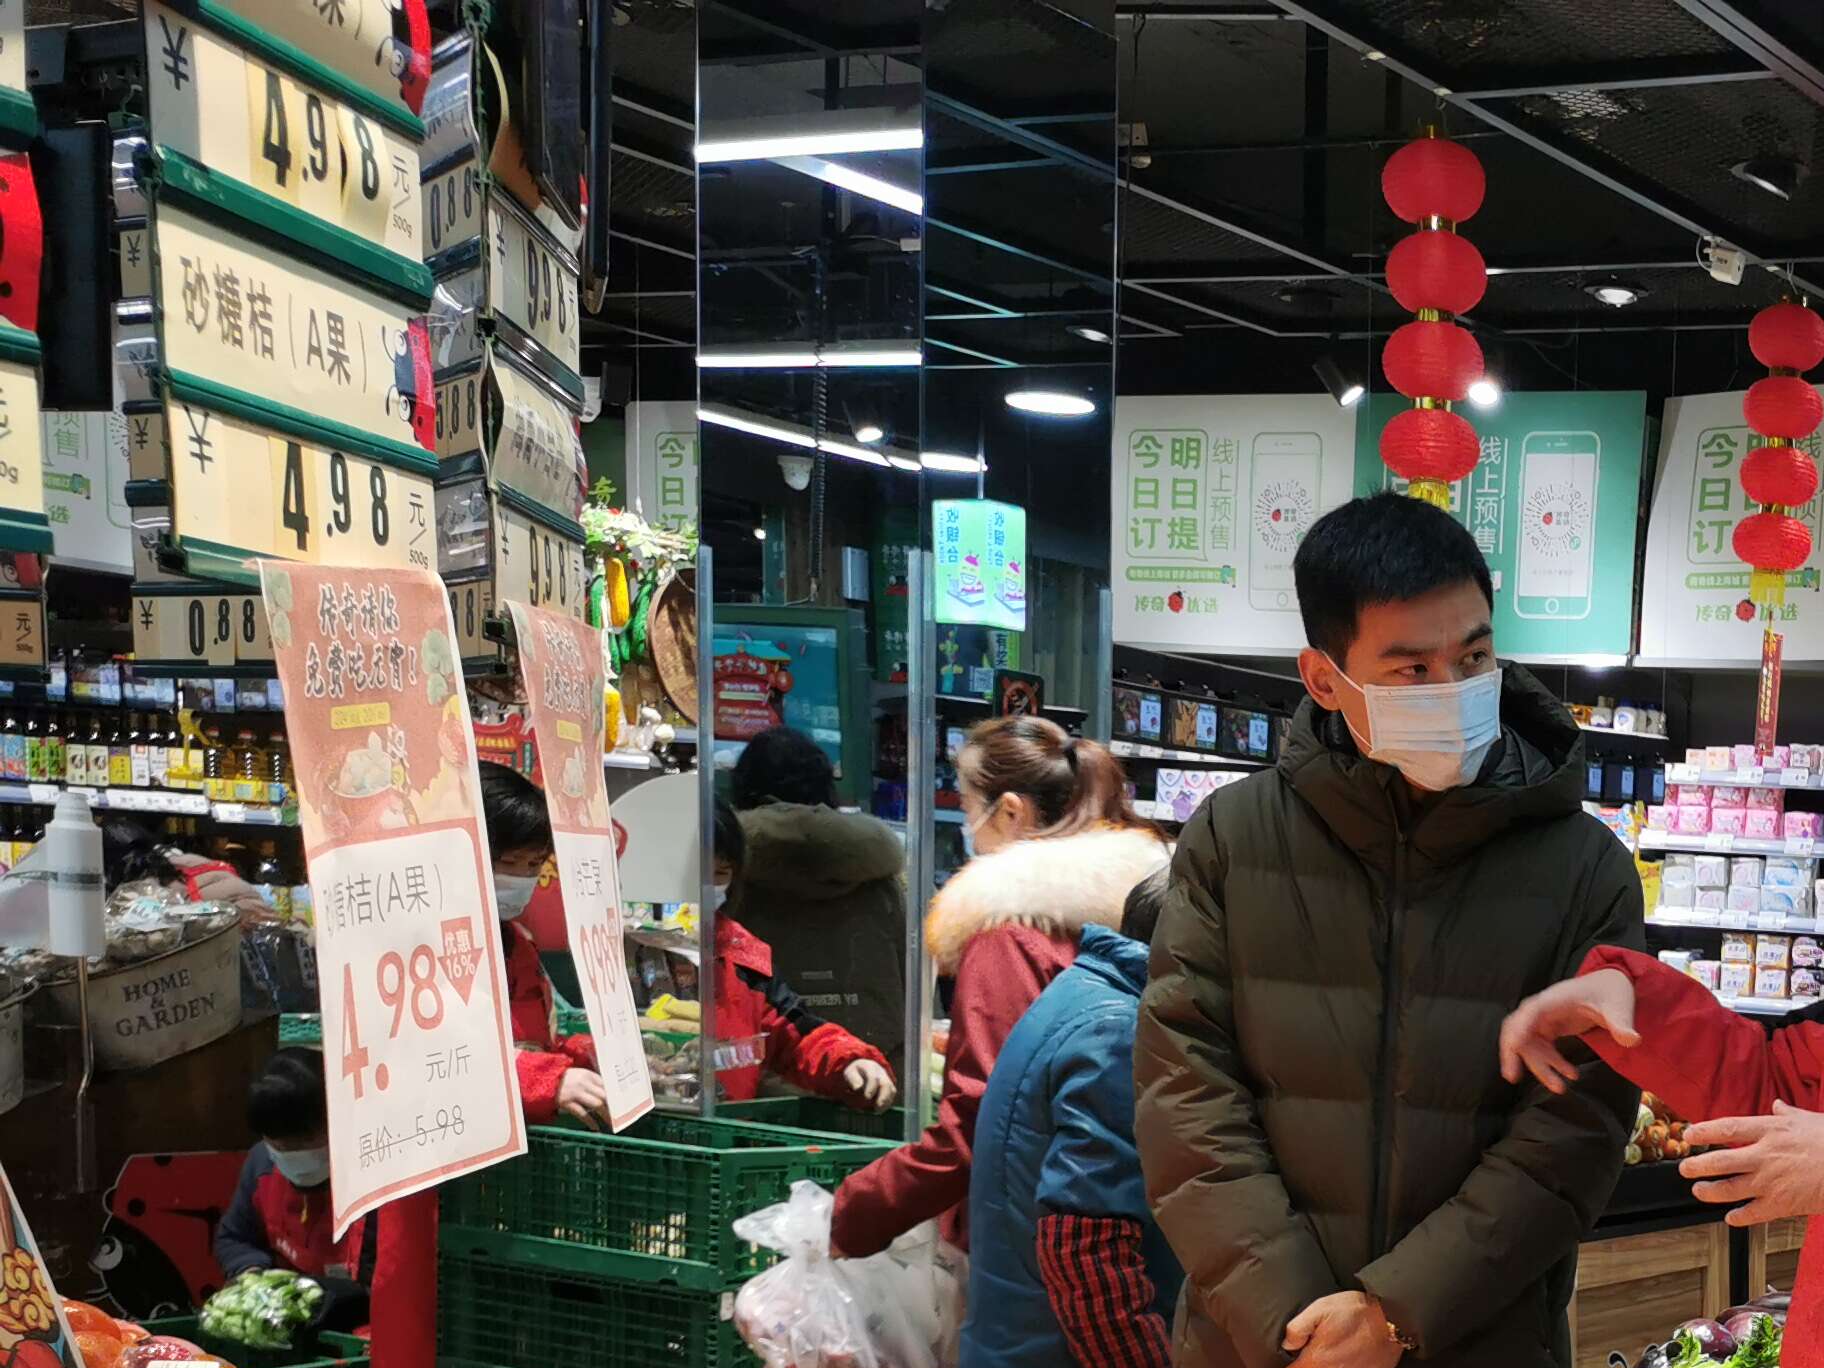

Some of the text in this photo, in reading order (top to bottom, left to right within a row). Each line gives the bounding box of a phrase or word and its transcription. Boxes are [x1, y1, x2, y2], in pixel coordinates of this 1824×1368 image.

[262, 70, 379, 200] 4.98
[283, 440, 389, 551] 4.98
[1130, 435, 1163, 550] 今日订
[1167, 436, 1201, 551] 明日提
[1210, 437, 1235, 552] 线上预售
[1693, 433, 1738, 554] 今日订
[189, 598, 256, 656] 0.88
[122, 968, 192, 1003] HOME
[444, 930, 471, 955] 优惠
[115, 993, 217, 1038] GARDEN
[342, 944, 444, 1101] 4.98
[426, 1045, 472, 1083] 元/斤
